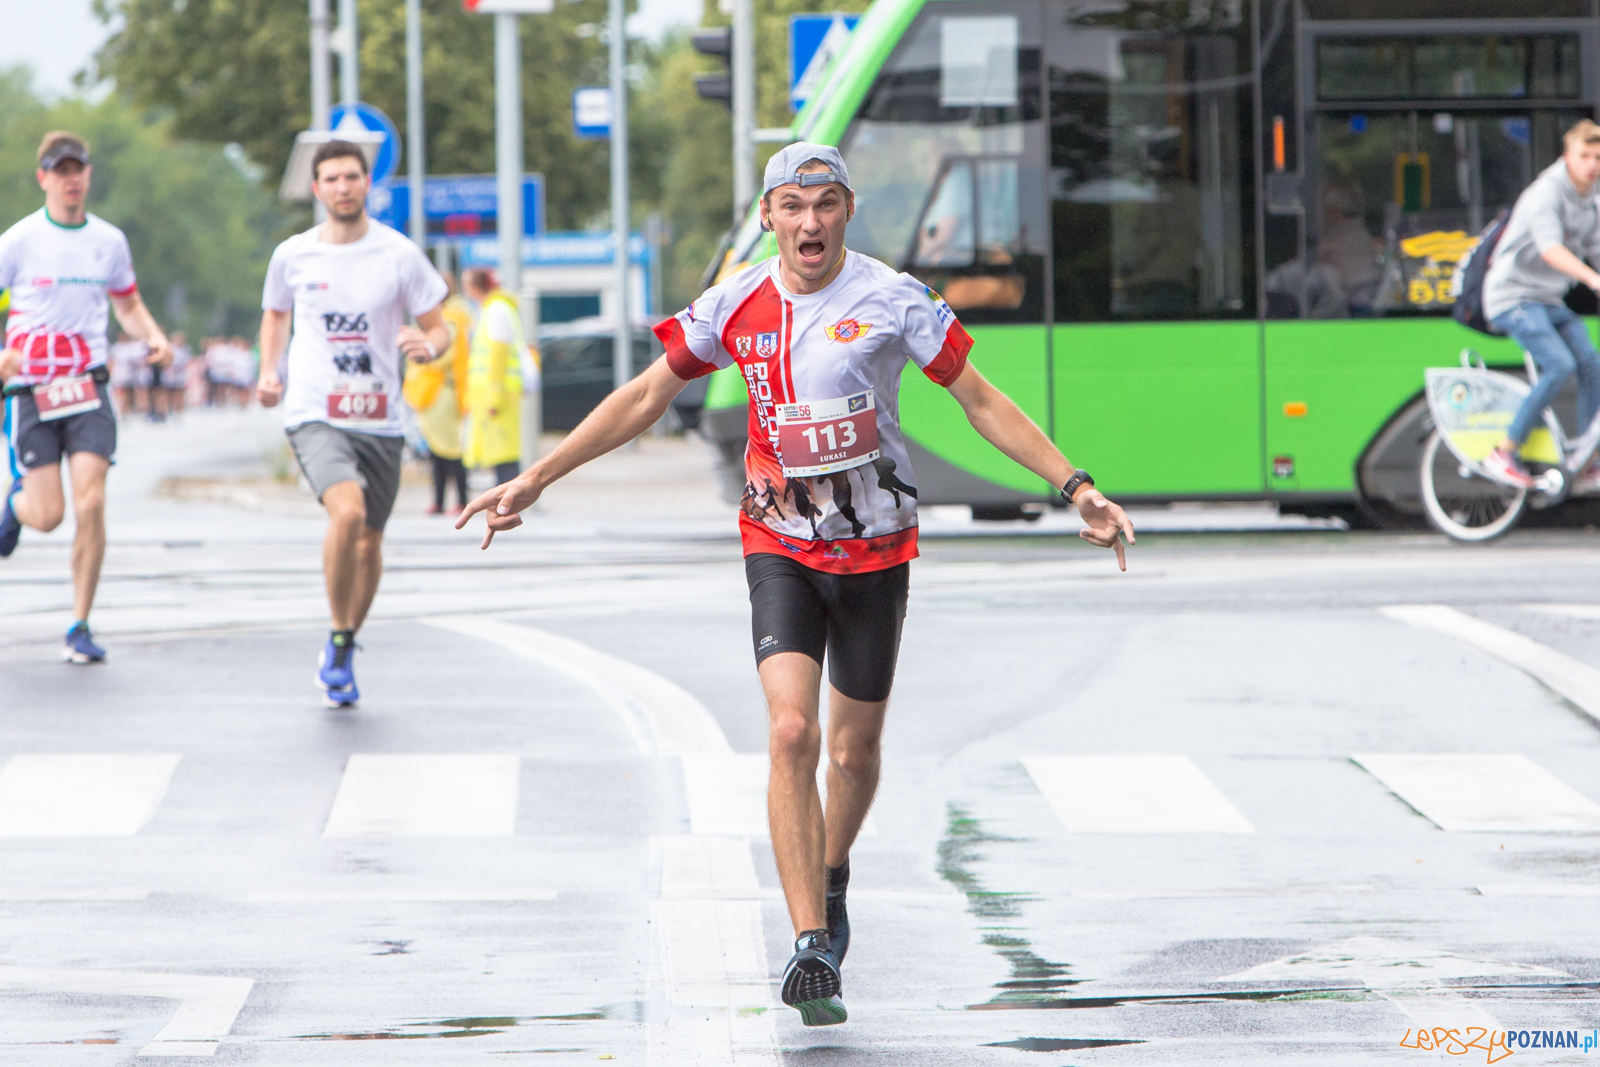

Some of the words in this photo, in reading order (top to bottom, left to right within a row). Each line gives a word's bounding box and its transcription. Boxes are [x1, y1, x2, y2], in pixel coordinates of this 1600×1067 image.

[320, 312, 369, 333] 1956
[337, 395, 379, 415] 409
[801, 420, 858, 454] 113
[820, 451, 848, 462] ŁUKASZ
